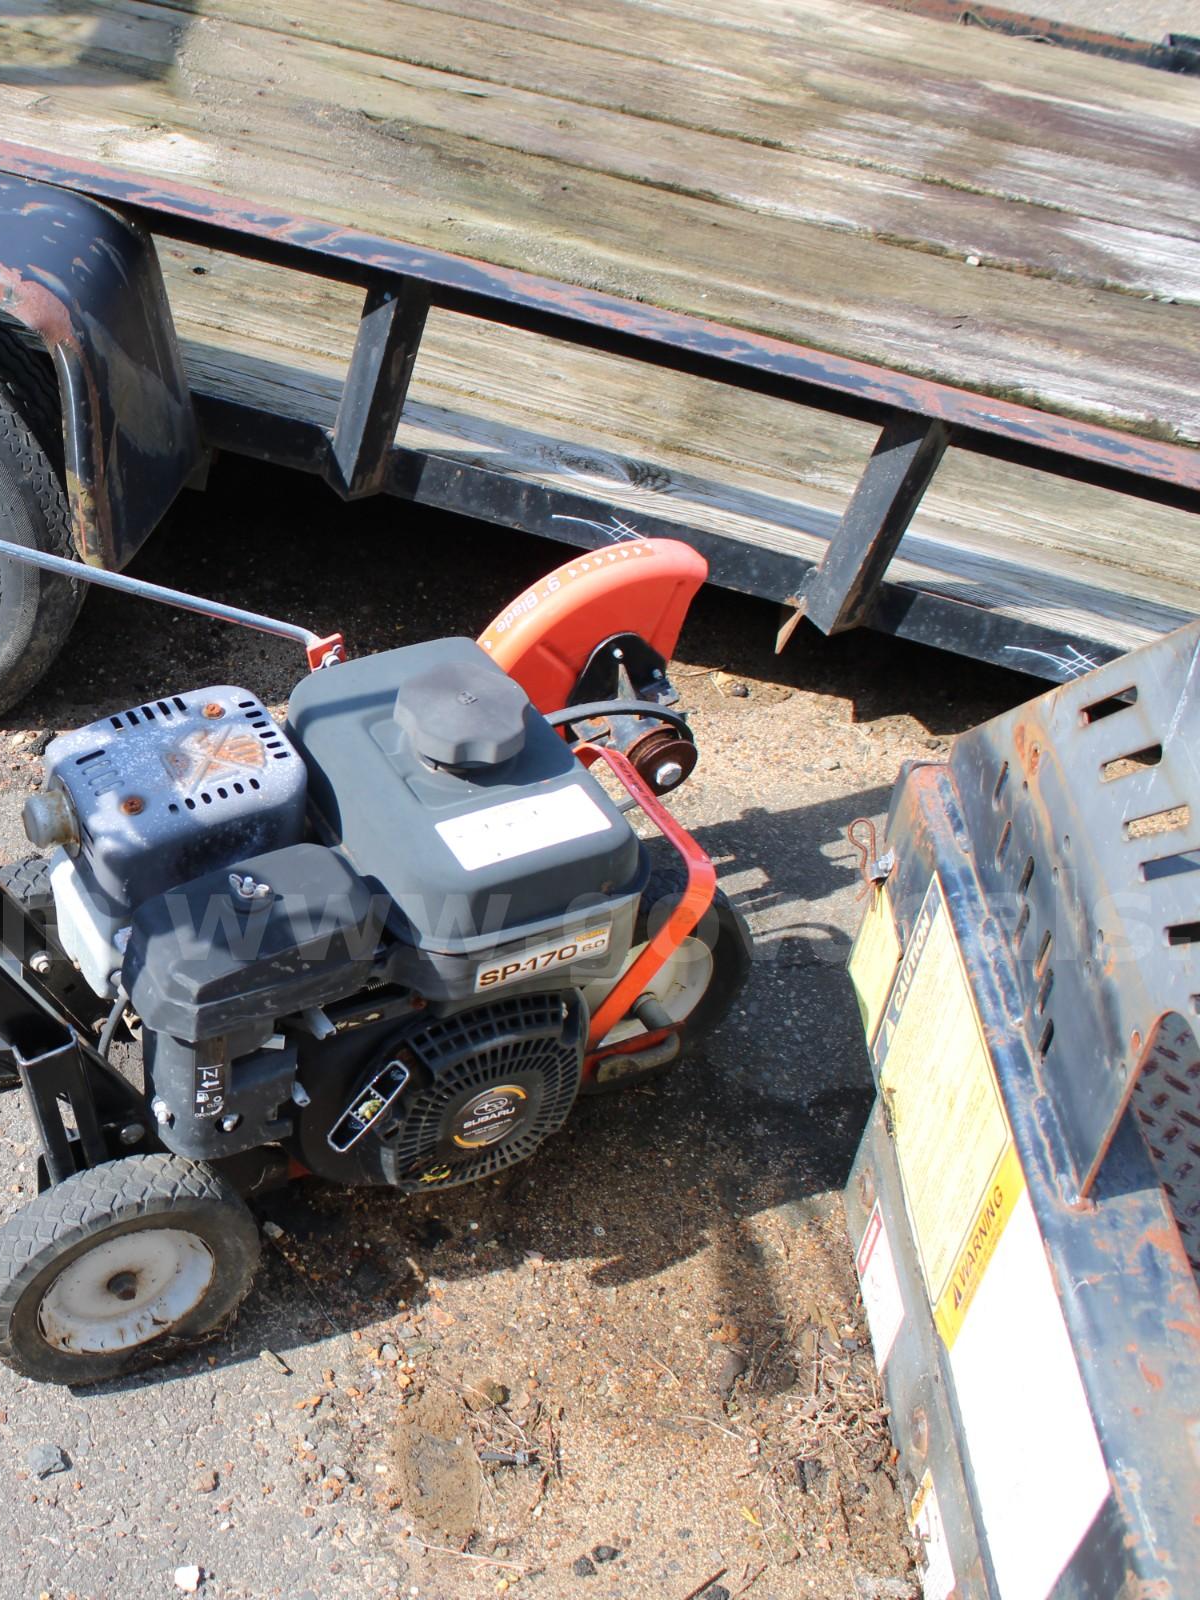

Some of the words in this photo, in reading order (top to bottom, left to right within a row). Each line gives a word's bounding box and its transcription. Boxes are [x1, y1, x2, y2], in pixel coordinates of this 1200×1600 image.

[495, 592, 538, 633] Blade
[479, 944, 578, 986] SP-170
[895, 911, 931, 1013] CAUTION
[463, 1107, 516, 1129] SUBARU
[959, 1185, 1004, 1287] WARNING
